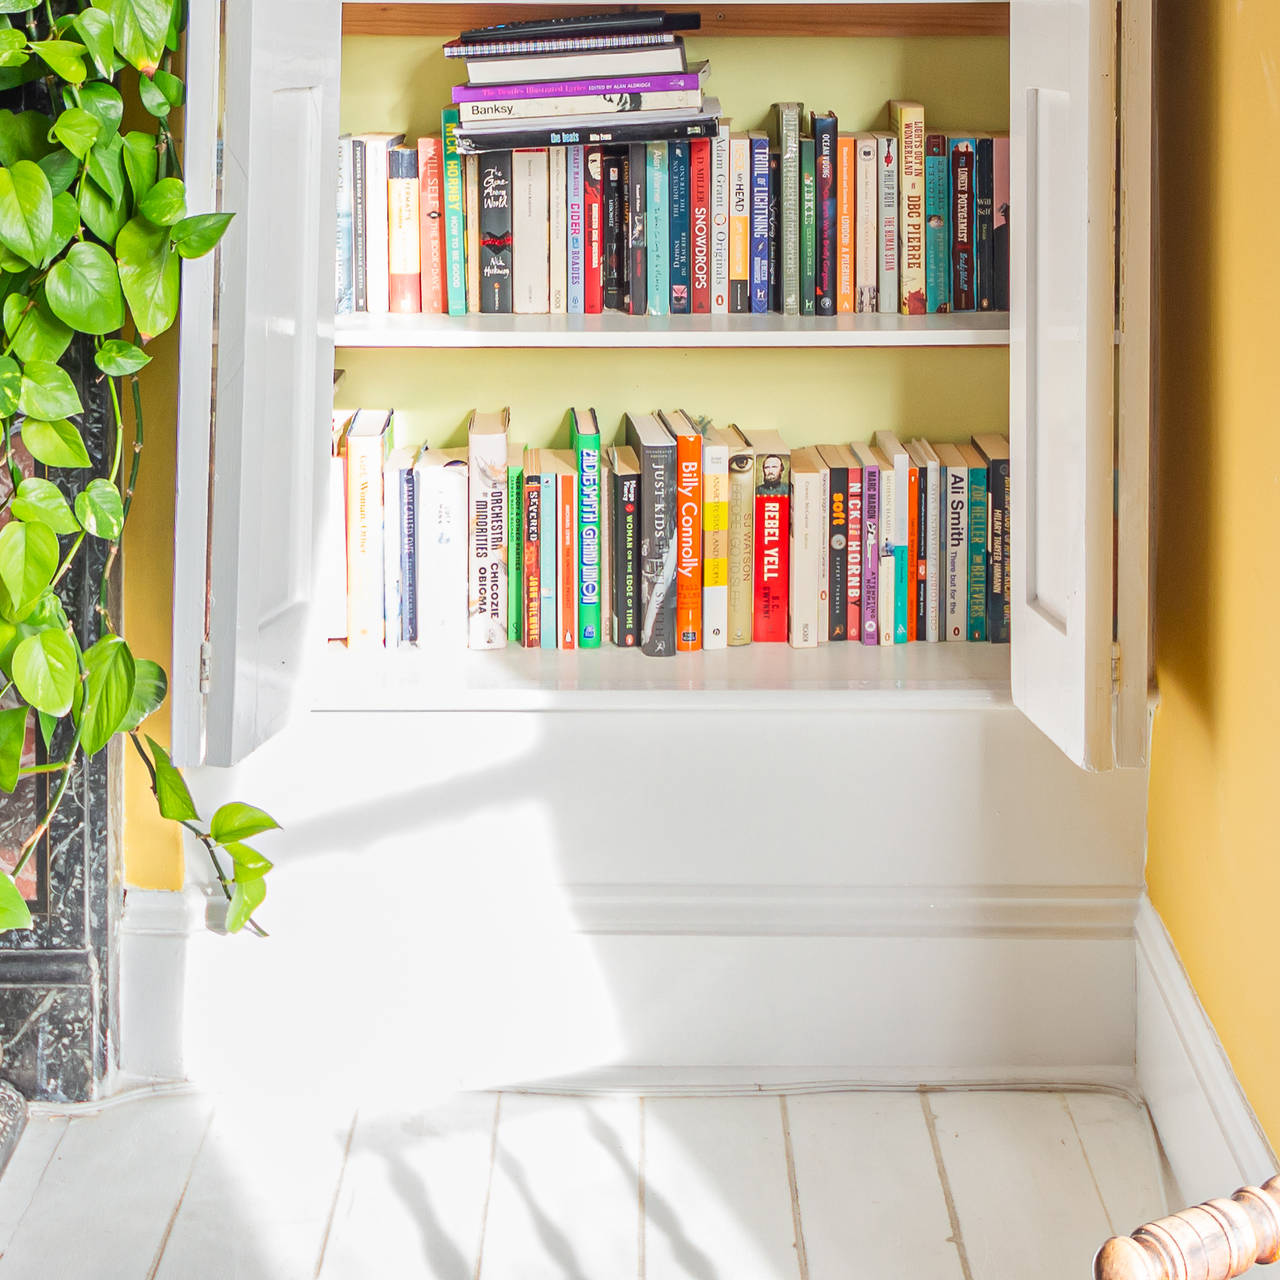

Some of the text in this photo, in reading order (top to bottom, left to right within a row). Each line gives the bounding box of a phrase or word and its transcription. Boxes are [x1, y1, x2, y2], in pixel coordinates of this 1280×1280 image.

[471, 104, 513, 116] Banksy
[914, 121, 923, 148] LIGHTS
[445, 123, 459, 211] NICK HORNBY
[755, 148, 768, 176] TRAIL
[904, 123, 913, 176] WONDERLAND
[914, 150, 922, 167] OUT
[427, 146, 439, 207] WILL SELF
[736, 183, 744, 212] HEAD
[884, 170, 894, 208] PHILIP ROTH
[711, 138, 726, 284] Adam Grant Originals
[754, 187, 768, 238] LIGHTNING
[958, 167, 968, 242] LONELY POLYGAMIST
[570, 203, 580, 285] CIDER ROADIES
[695, 208, 706, 288] SNOWDROPS
[907, 195, 921, 269] DBC PIERRE
[651, 463, 665, 538] JUST KIDS
[678, 462, 697, 497] Billy
[867, 471, 876, 519] MARC MARON
[476, 501, 488, 558] MINORITIES
[491, 491, 503, 551] ORCHESTRA
[529, 491, 538, 541] SEVERED
[832, 493, 845, 525] soft
[951, 474, 964, 547] Ali Smith
[626, 550, 632, 560] ON
[678, 502, 697, 577] Connolly
[764, 503, 779, 581] REBEL YELL
[478, 567, 486, 614] OBIOMA
[490, 563, 499, 619] CHIGOZIE
[626, 599, 632, 607] OF
